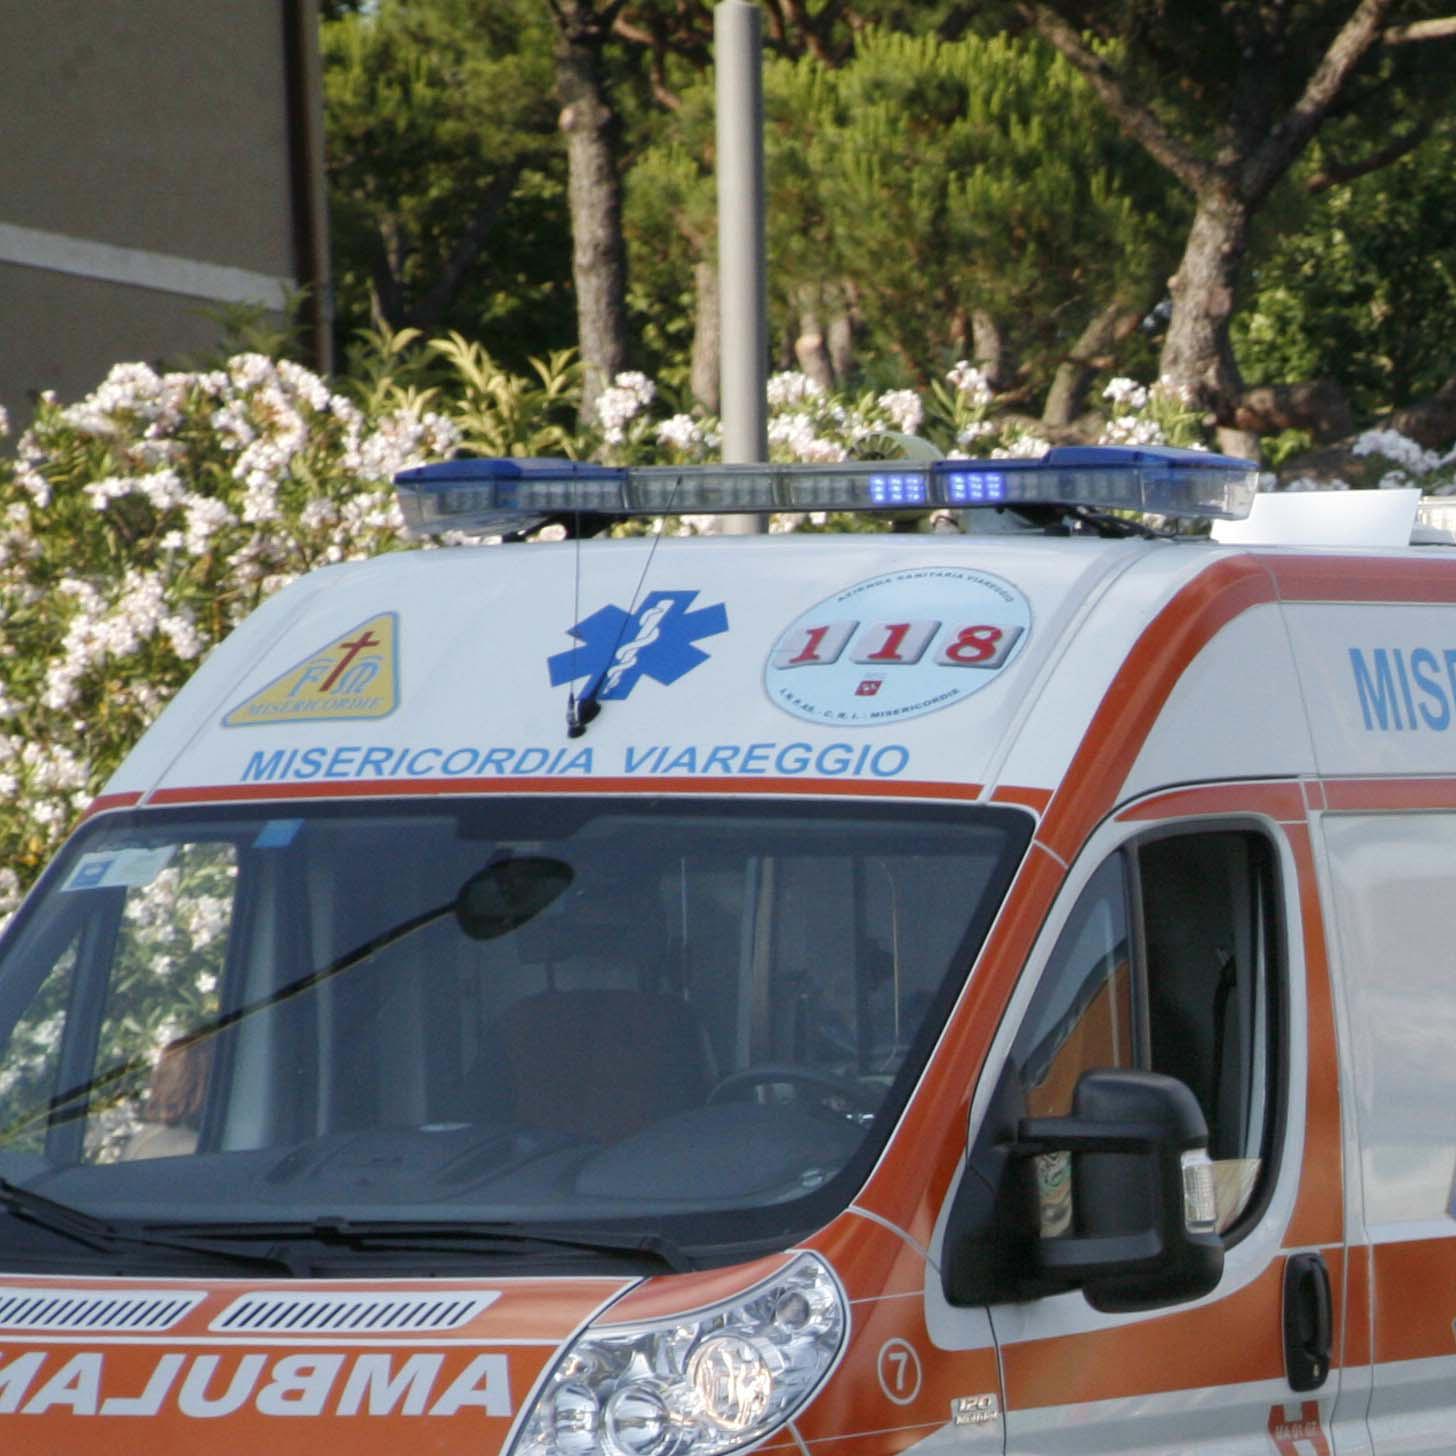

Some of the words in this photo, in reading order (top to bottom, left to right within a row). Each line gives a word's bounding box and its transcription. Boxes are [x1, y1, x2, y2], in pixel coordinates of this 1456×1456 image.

[788, 622, 1003, 665] 118
[240, 746, 595, 782] MISERICORDIA
[621, 743, 910, 777] VIAREGGIO
[888, 1352, 908, 1391] 7
